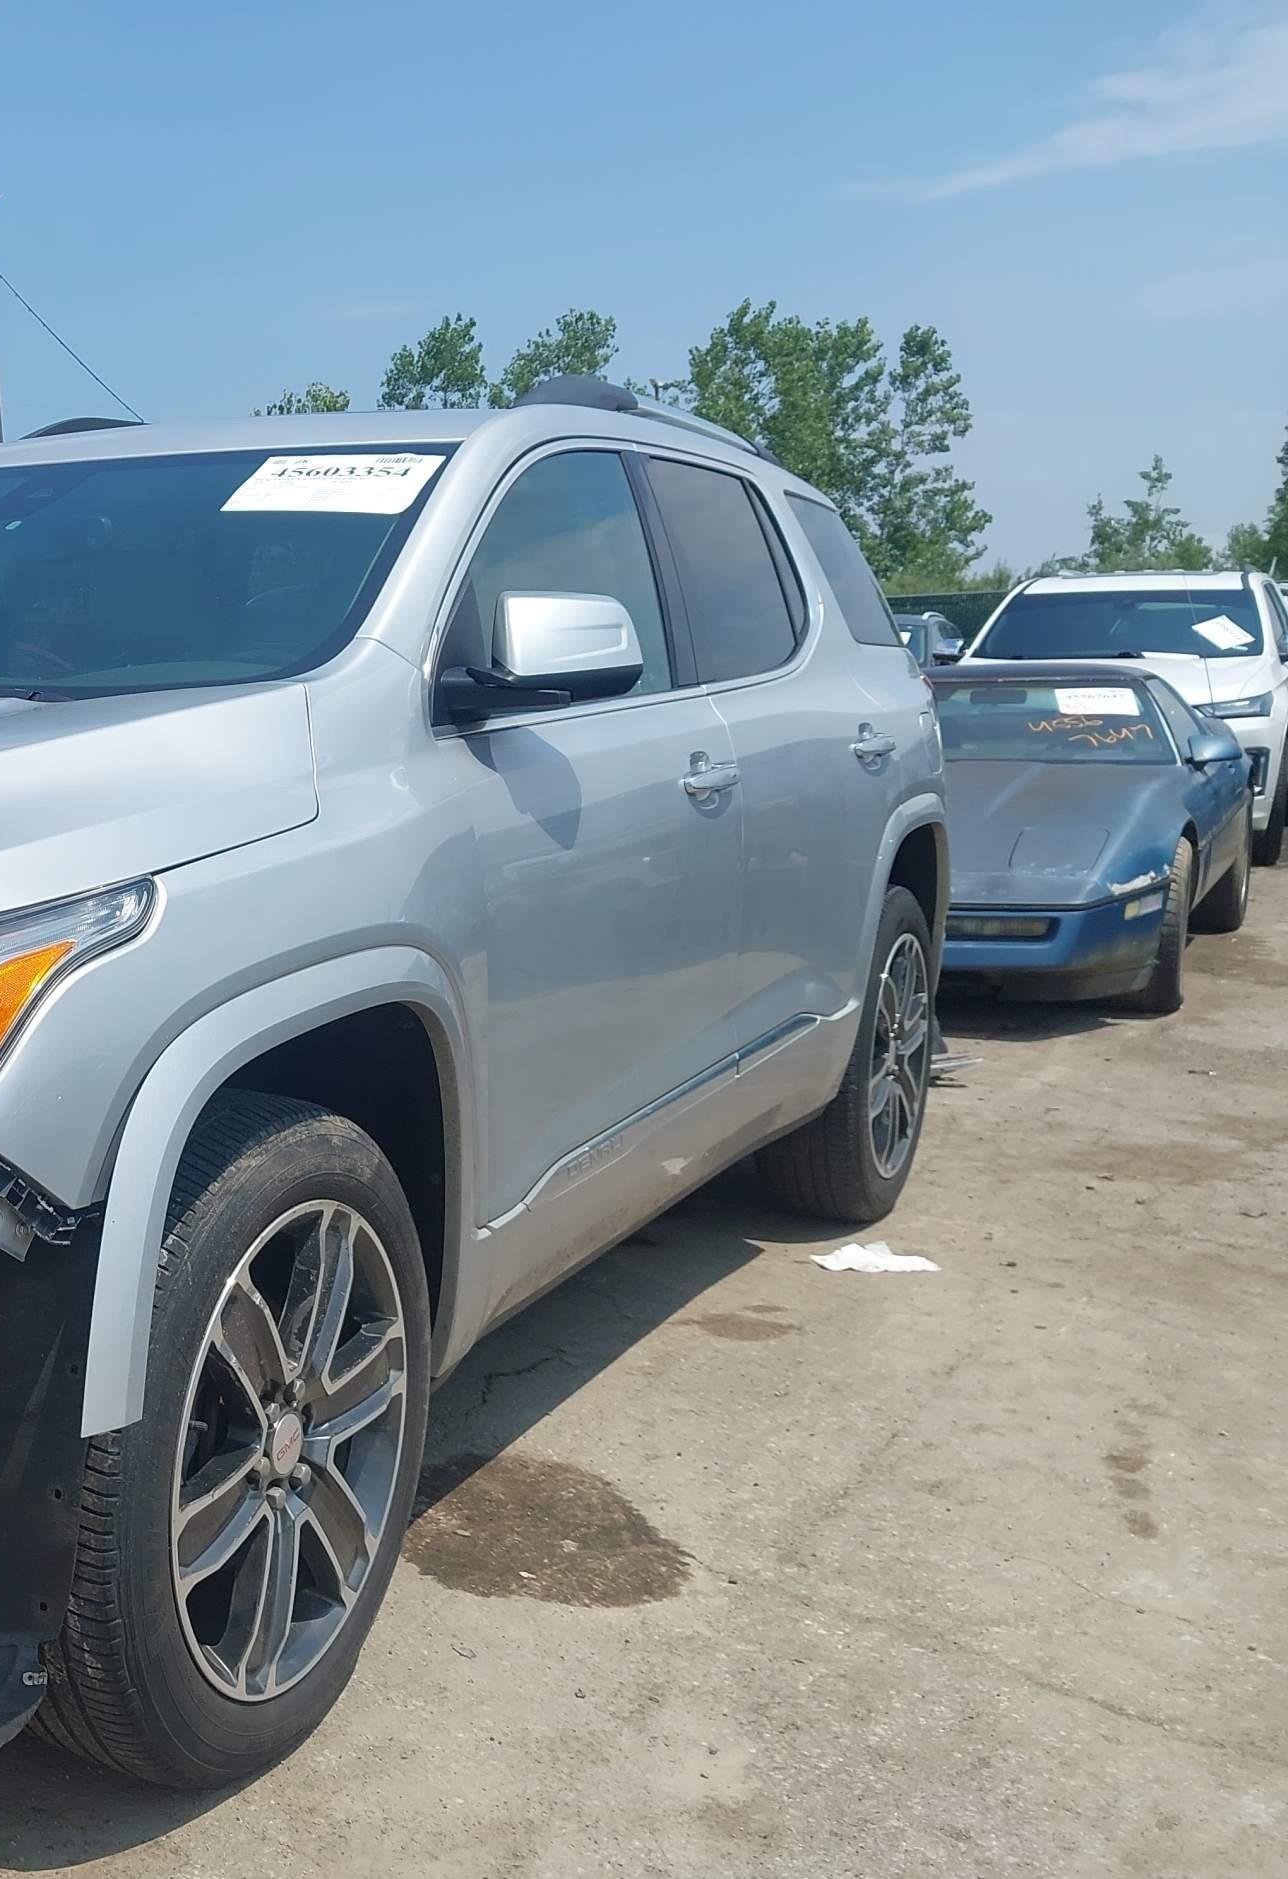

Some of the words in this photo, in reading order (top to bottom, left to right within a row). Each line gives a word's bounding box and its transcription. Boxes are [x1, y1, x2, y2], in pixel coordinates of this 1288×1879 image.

[271, 466, 413, 478] 45603354
[1067, 723, 1154, 747] 7647
[566, 1134, 624, 1180] DENALI
[276, 1427, 301, 1461] GMC
